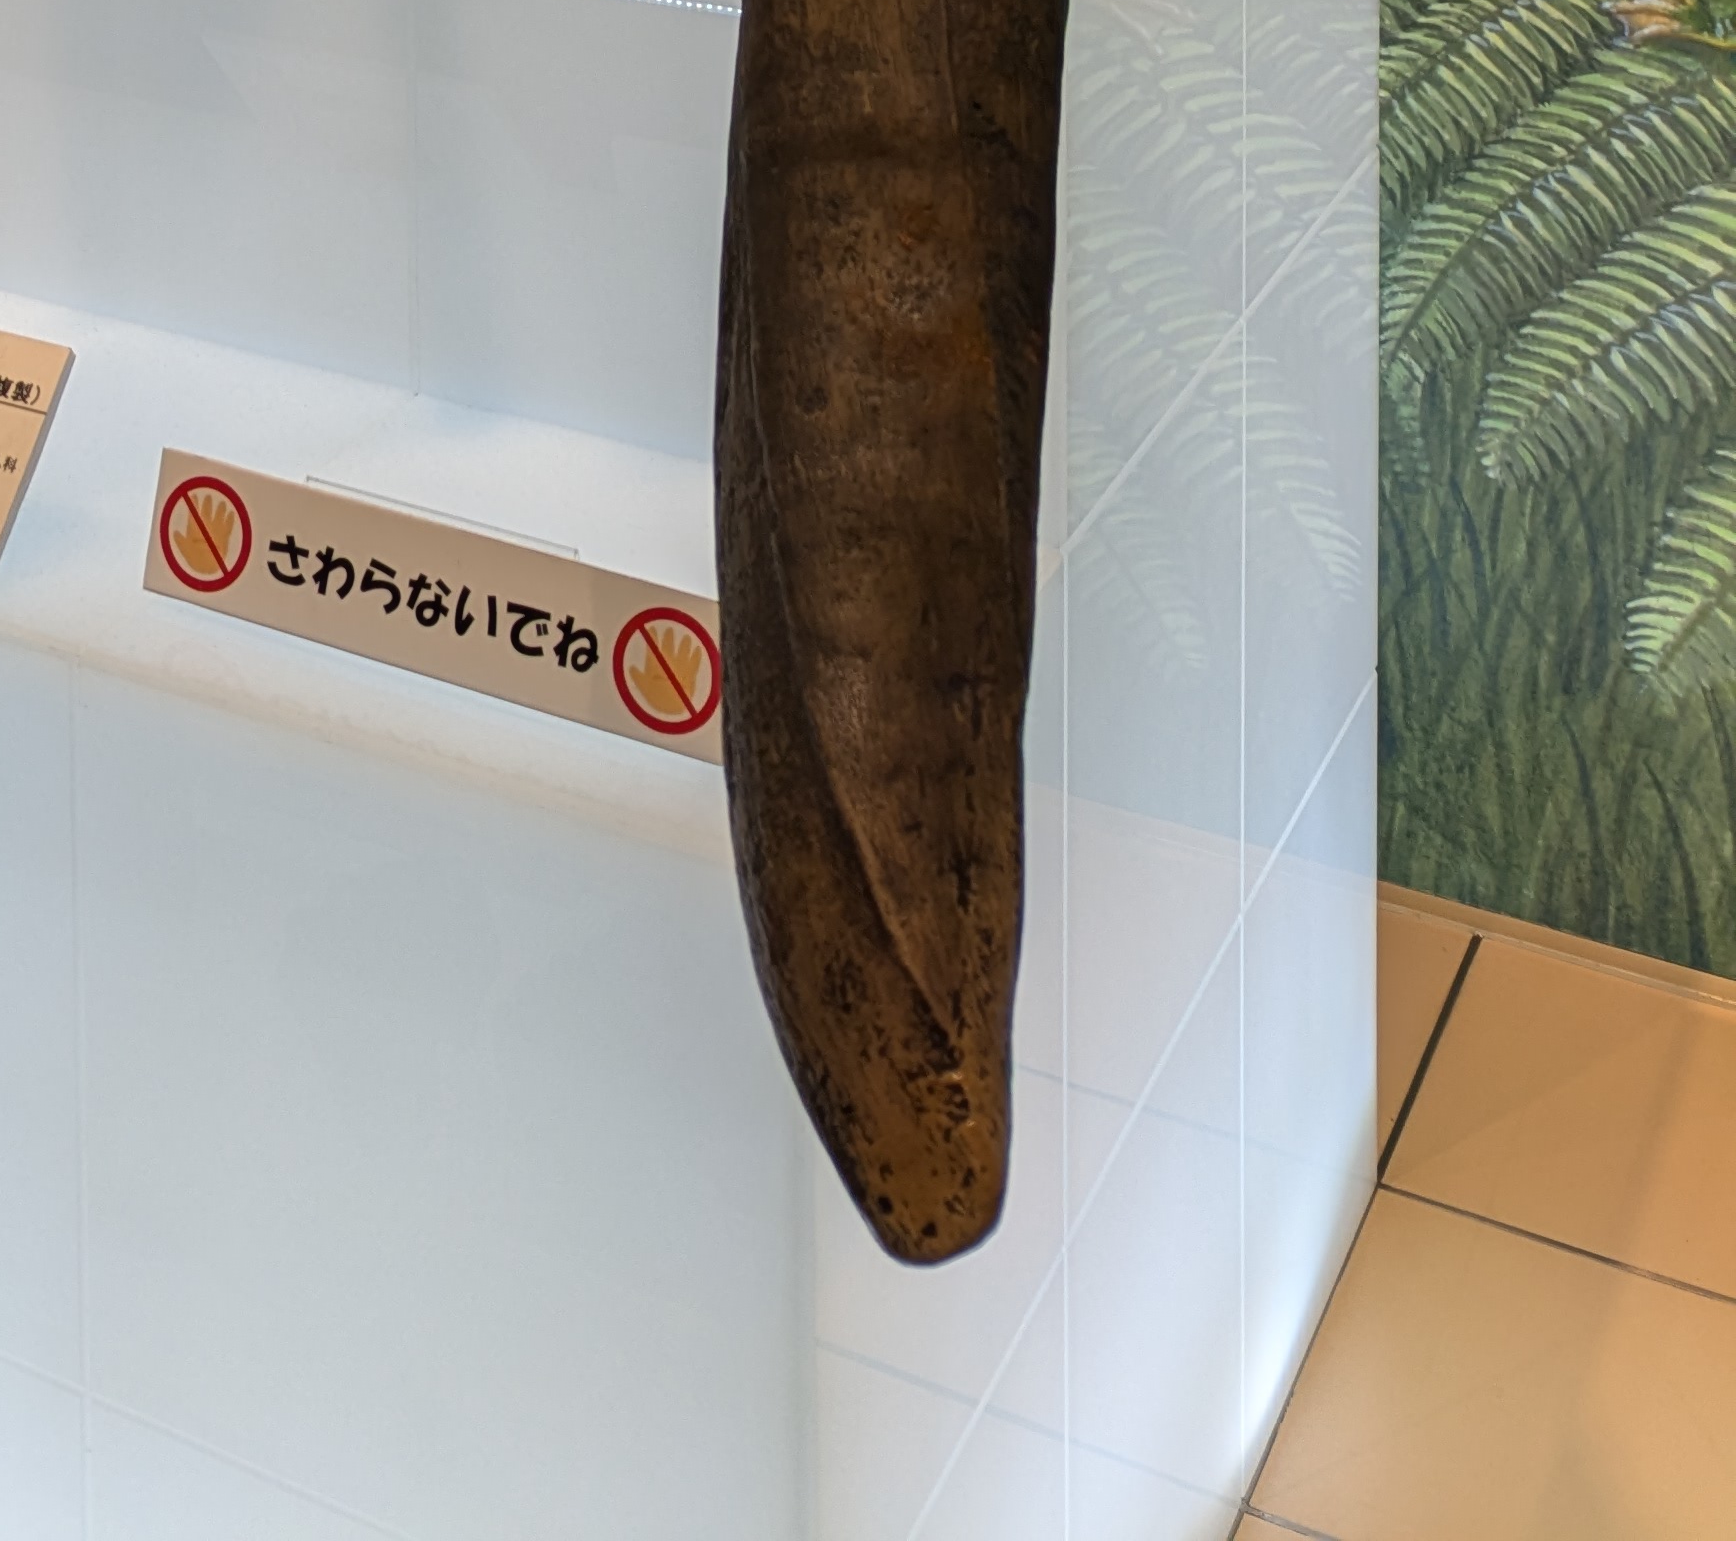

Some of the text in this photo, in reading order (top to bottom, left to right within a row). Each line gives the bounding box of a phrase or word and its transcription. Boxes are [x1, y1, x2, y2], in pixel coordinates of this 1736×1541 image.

[266, 534, 600, 673] さわらないでね
